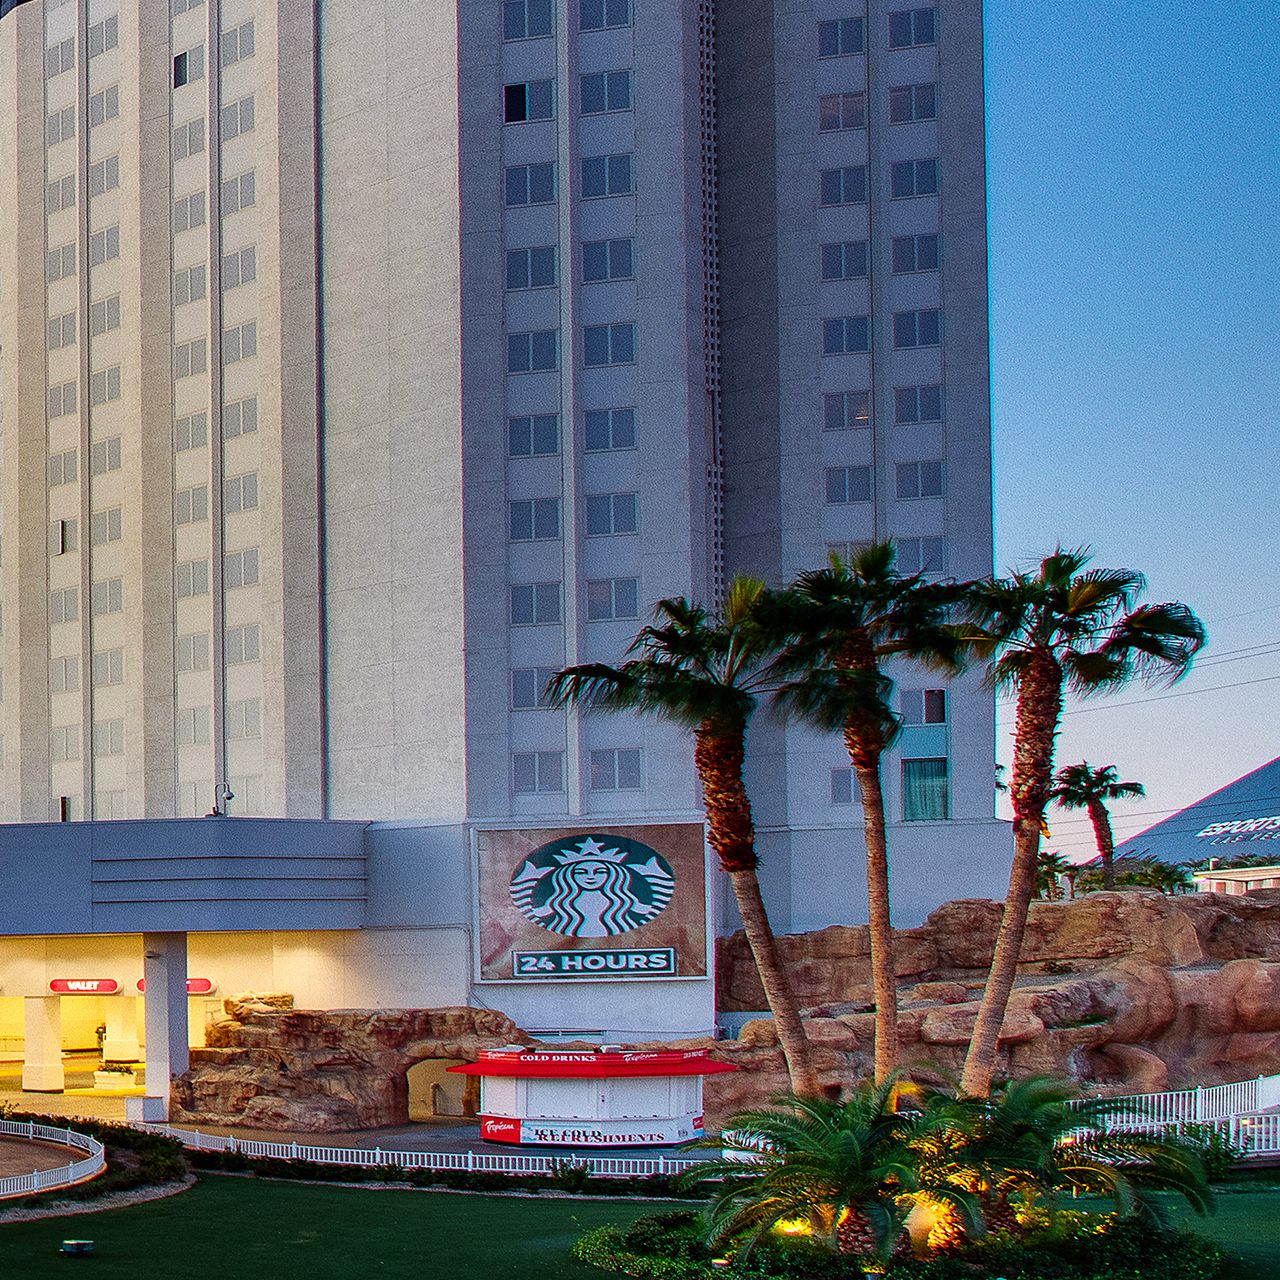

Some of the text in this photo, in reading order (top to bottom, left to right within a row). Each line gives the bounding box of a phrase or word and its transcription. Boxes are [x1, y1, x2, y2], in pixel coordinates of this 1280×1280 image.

[519, 953, 668, 972] 24 HOURS
[66, 981, 100, 990] VALET
[520, 1054, 596, 1062] COLD DRINKS
[485, 1119, 515, 1134] Tropicana
